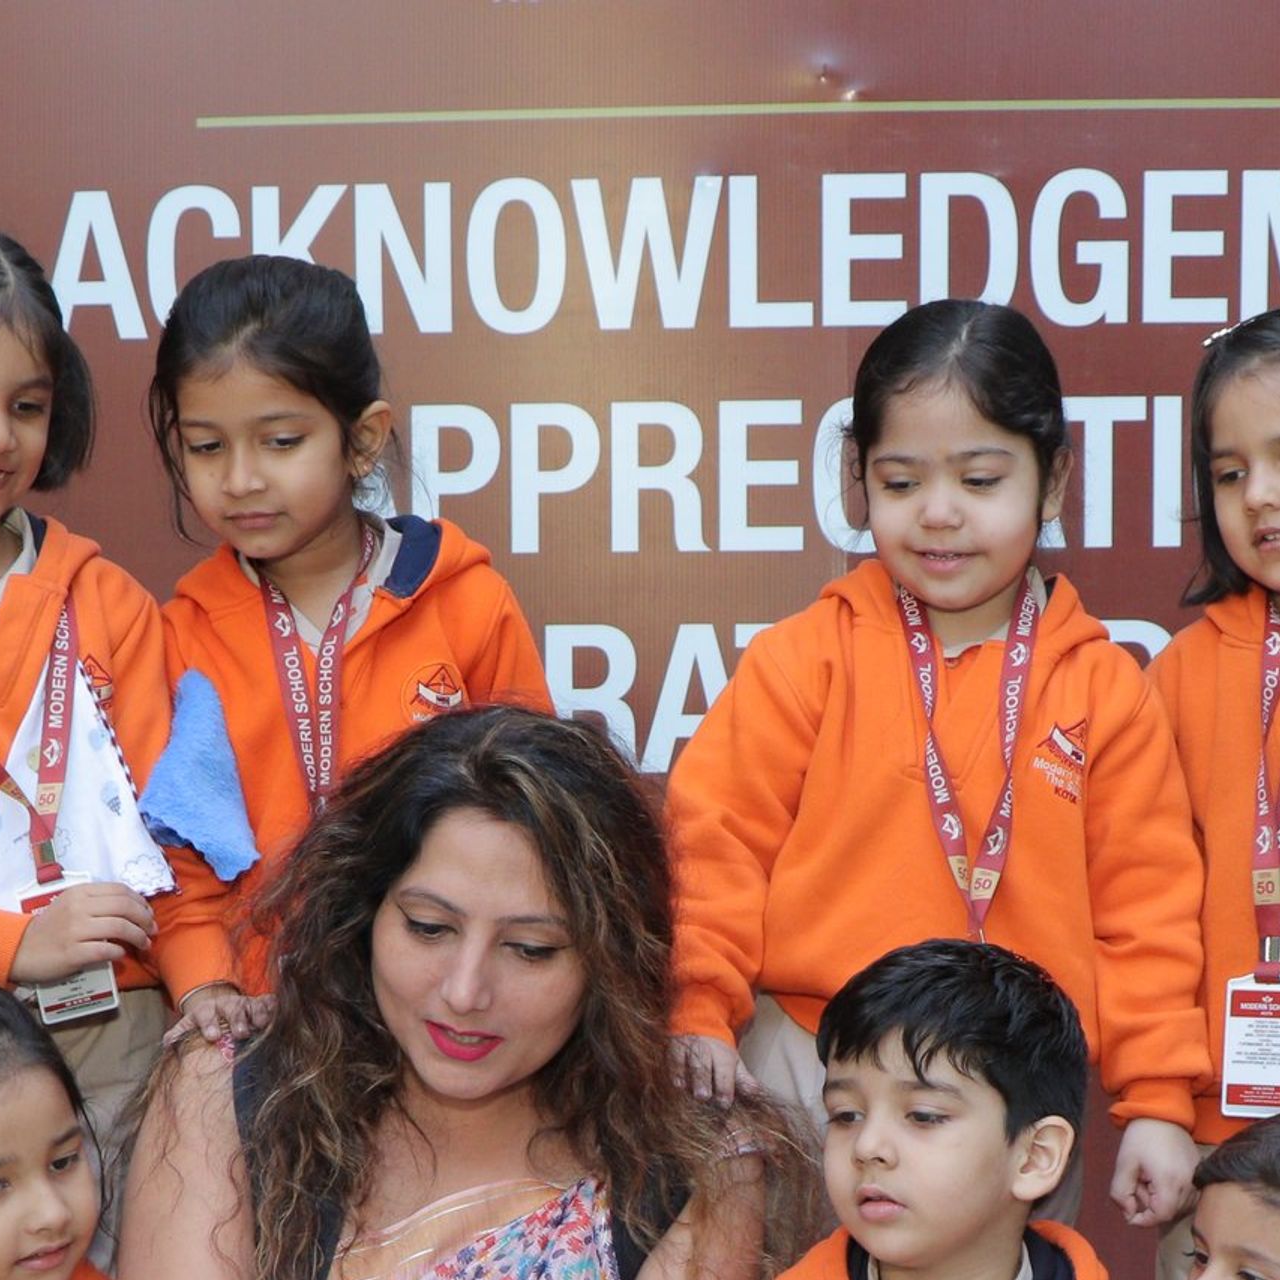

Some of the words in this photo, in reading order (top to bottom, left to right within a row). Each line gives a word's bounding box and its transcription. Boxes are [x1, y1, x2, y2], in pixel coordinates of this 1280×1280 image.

[49, 651, 68, 728] MODERN
[284, 646, 308, 714] SCHOOL
[319, 634, 338, 705] SCHOOL
[1003, 674, 1023, 745] SCHOOL
[297, 718, 317, 792] MODERN
[320, 709, 333, 786] MODERN
[38, 793, 56, 807] 50
[973, 876, 993, 891] 50
[1256, 881, 1276, 895] 50
